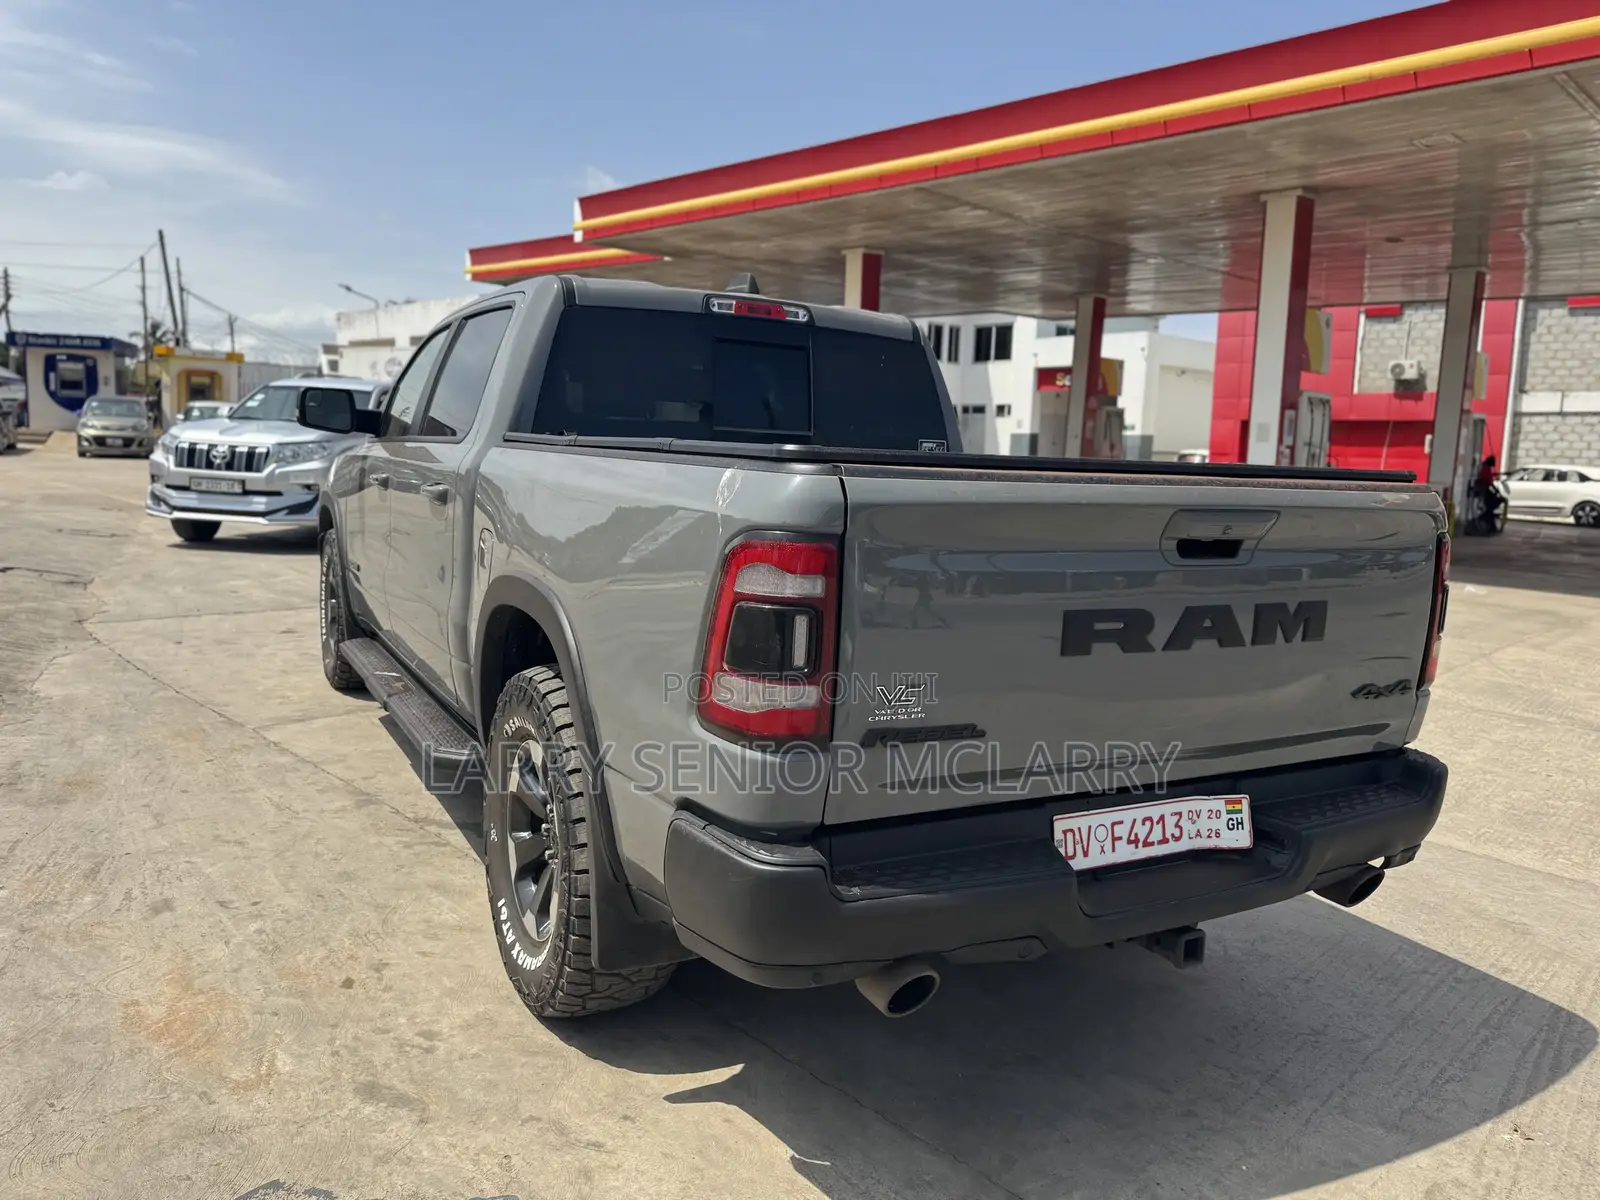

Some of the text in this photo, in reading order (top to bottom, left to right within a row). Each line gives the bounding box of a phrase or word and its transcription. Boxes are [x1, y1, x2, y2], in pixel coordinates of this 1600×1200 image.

[1060, 600, 1328, 657] RAM
[868, 713, 926, 722] CHRYSLER
[859, 723, 987, 748] REBEL
[1207, 809, 1222, 820] 20
[1226, 816, 1245, 832] GH
[1111, 812, 1184, 853] F4213
[1206, 828, 1221, 839] 26
